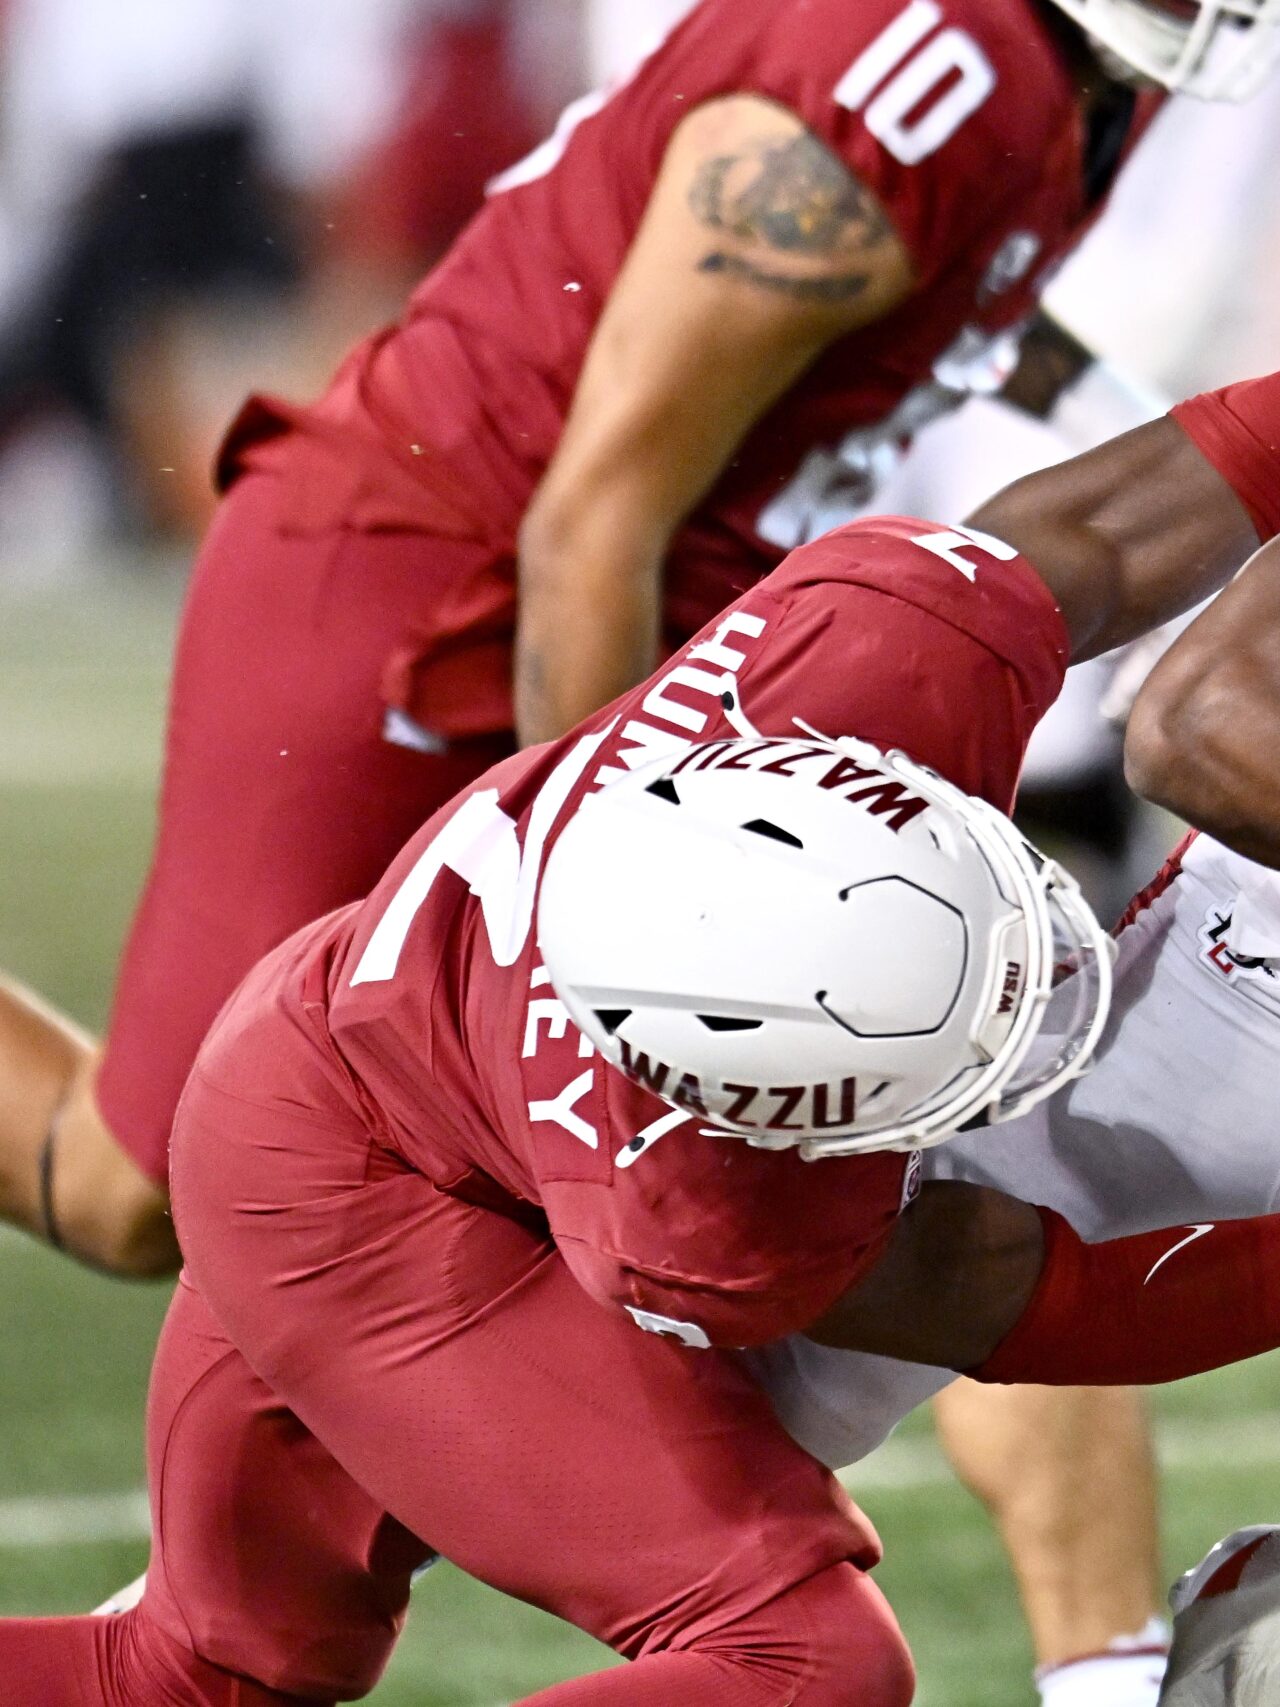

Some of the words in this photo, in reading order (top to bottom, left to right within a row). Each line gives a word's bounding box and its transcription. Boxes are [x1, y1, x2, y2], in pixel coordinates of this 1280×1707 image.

[833, 0, 998, 167] 10
[668, 739, 931, 835] WAZZU
[996, 961, 1021, 1014] WSU
[617, 1034, 857, 1131] WAZZU
